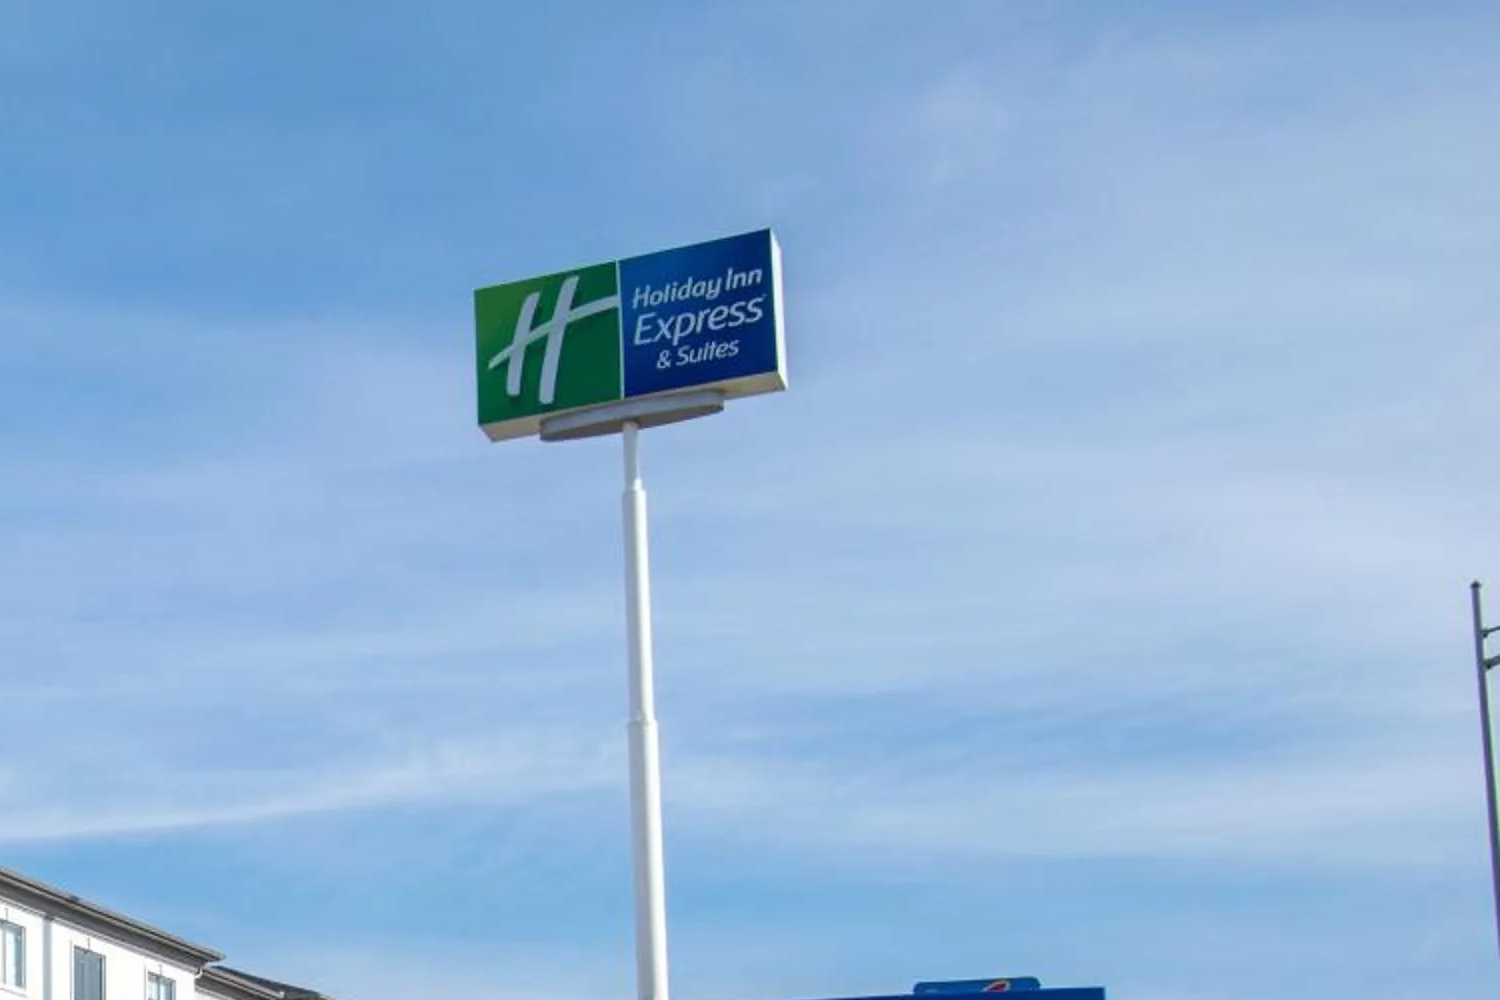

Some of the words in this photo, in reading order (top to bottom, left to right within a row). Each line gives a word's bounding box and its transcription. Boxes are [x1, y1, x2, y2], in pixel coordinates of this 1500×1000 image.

[632, 277, 722, 309] Holiday
[725, 267, 763, 290] Inn
[633, 297, 764, 346] Express
[656, 350, 672, 369] &
[676, 339, 740, 366] Suites
